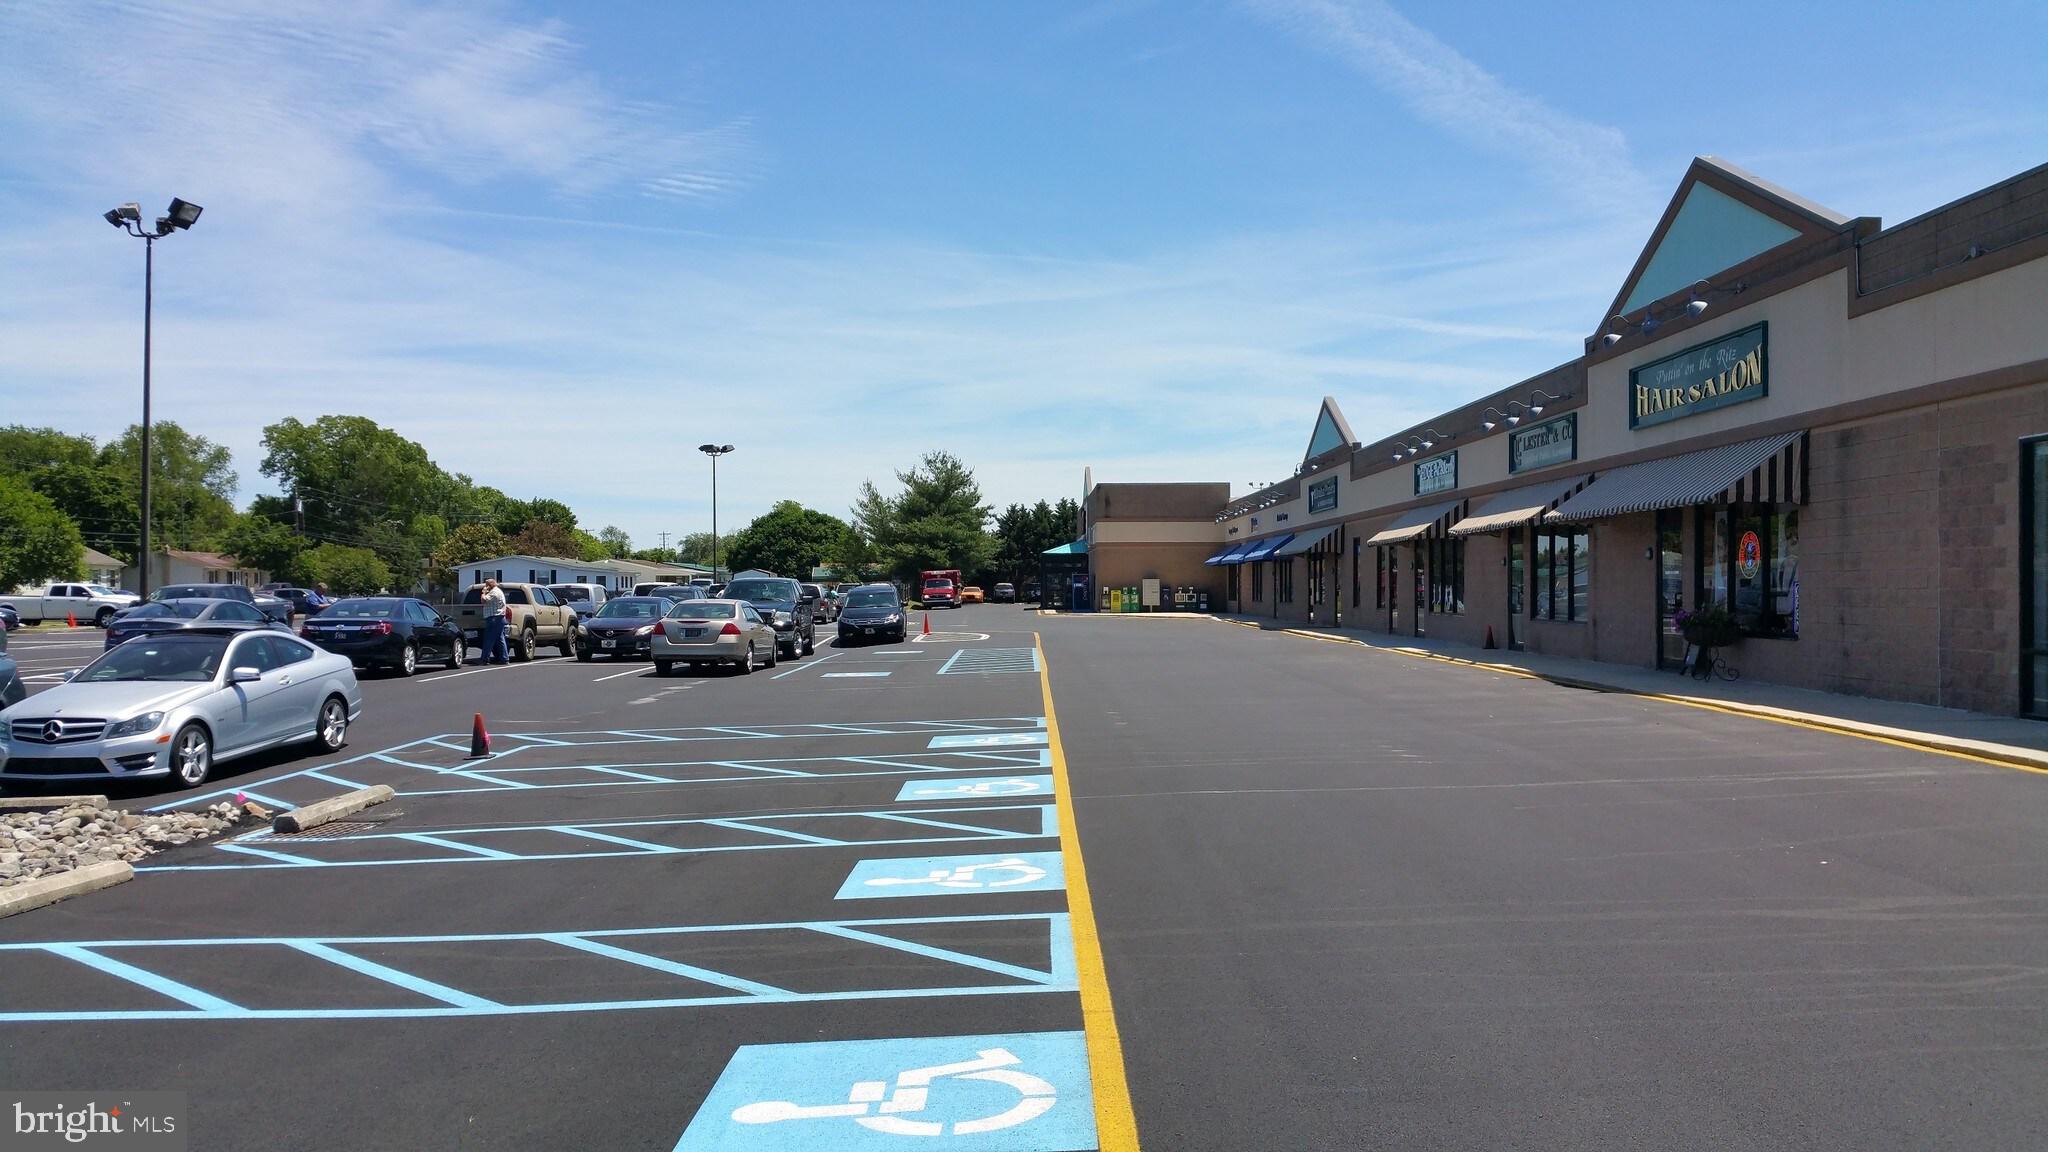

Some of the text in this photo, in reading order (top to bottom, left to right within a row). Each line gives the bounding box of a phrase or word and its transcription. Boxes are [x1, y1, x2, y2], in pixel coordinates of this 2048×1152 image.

[1636, 343, 1763, 418] HAIR SALON
[1685, 365, 1695, 376] on
[1699, 348, 1712, 371] the
[1716, 347, 1737, 370] Ritz
